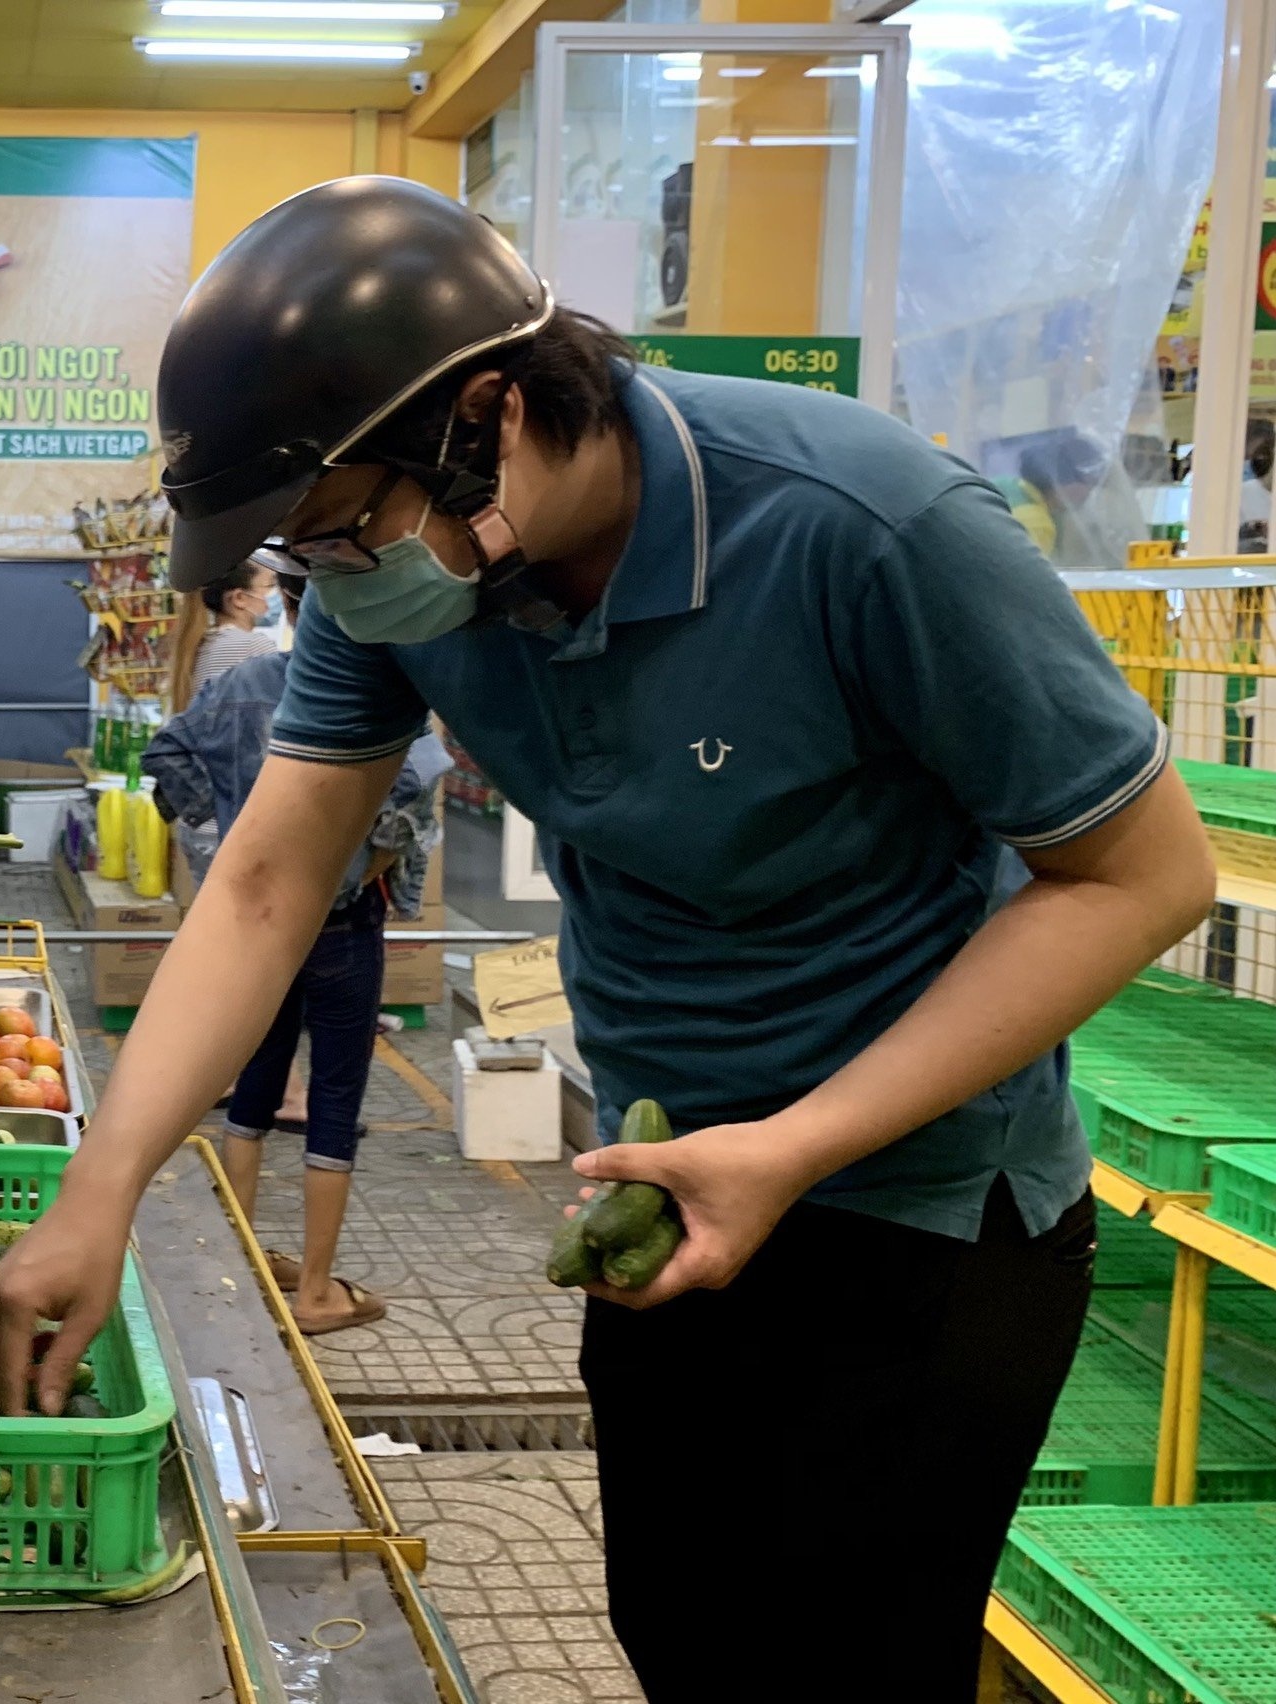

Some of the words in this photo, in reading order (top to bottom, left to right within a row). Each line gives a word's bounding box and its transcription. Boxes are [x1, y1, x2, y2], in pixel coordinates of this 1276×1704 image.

[37, 347, 129, 387] NGỌT,
[765, 349, 838, 373] 06:30
[25, 388, 55, 428] VỊ
[64, 389, 149, 422] NGON
[9, 434, 61, 458] SẠCH
[65, 435, 146, 456] VIETGAP
